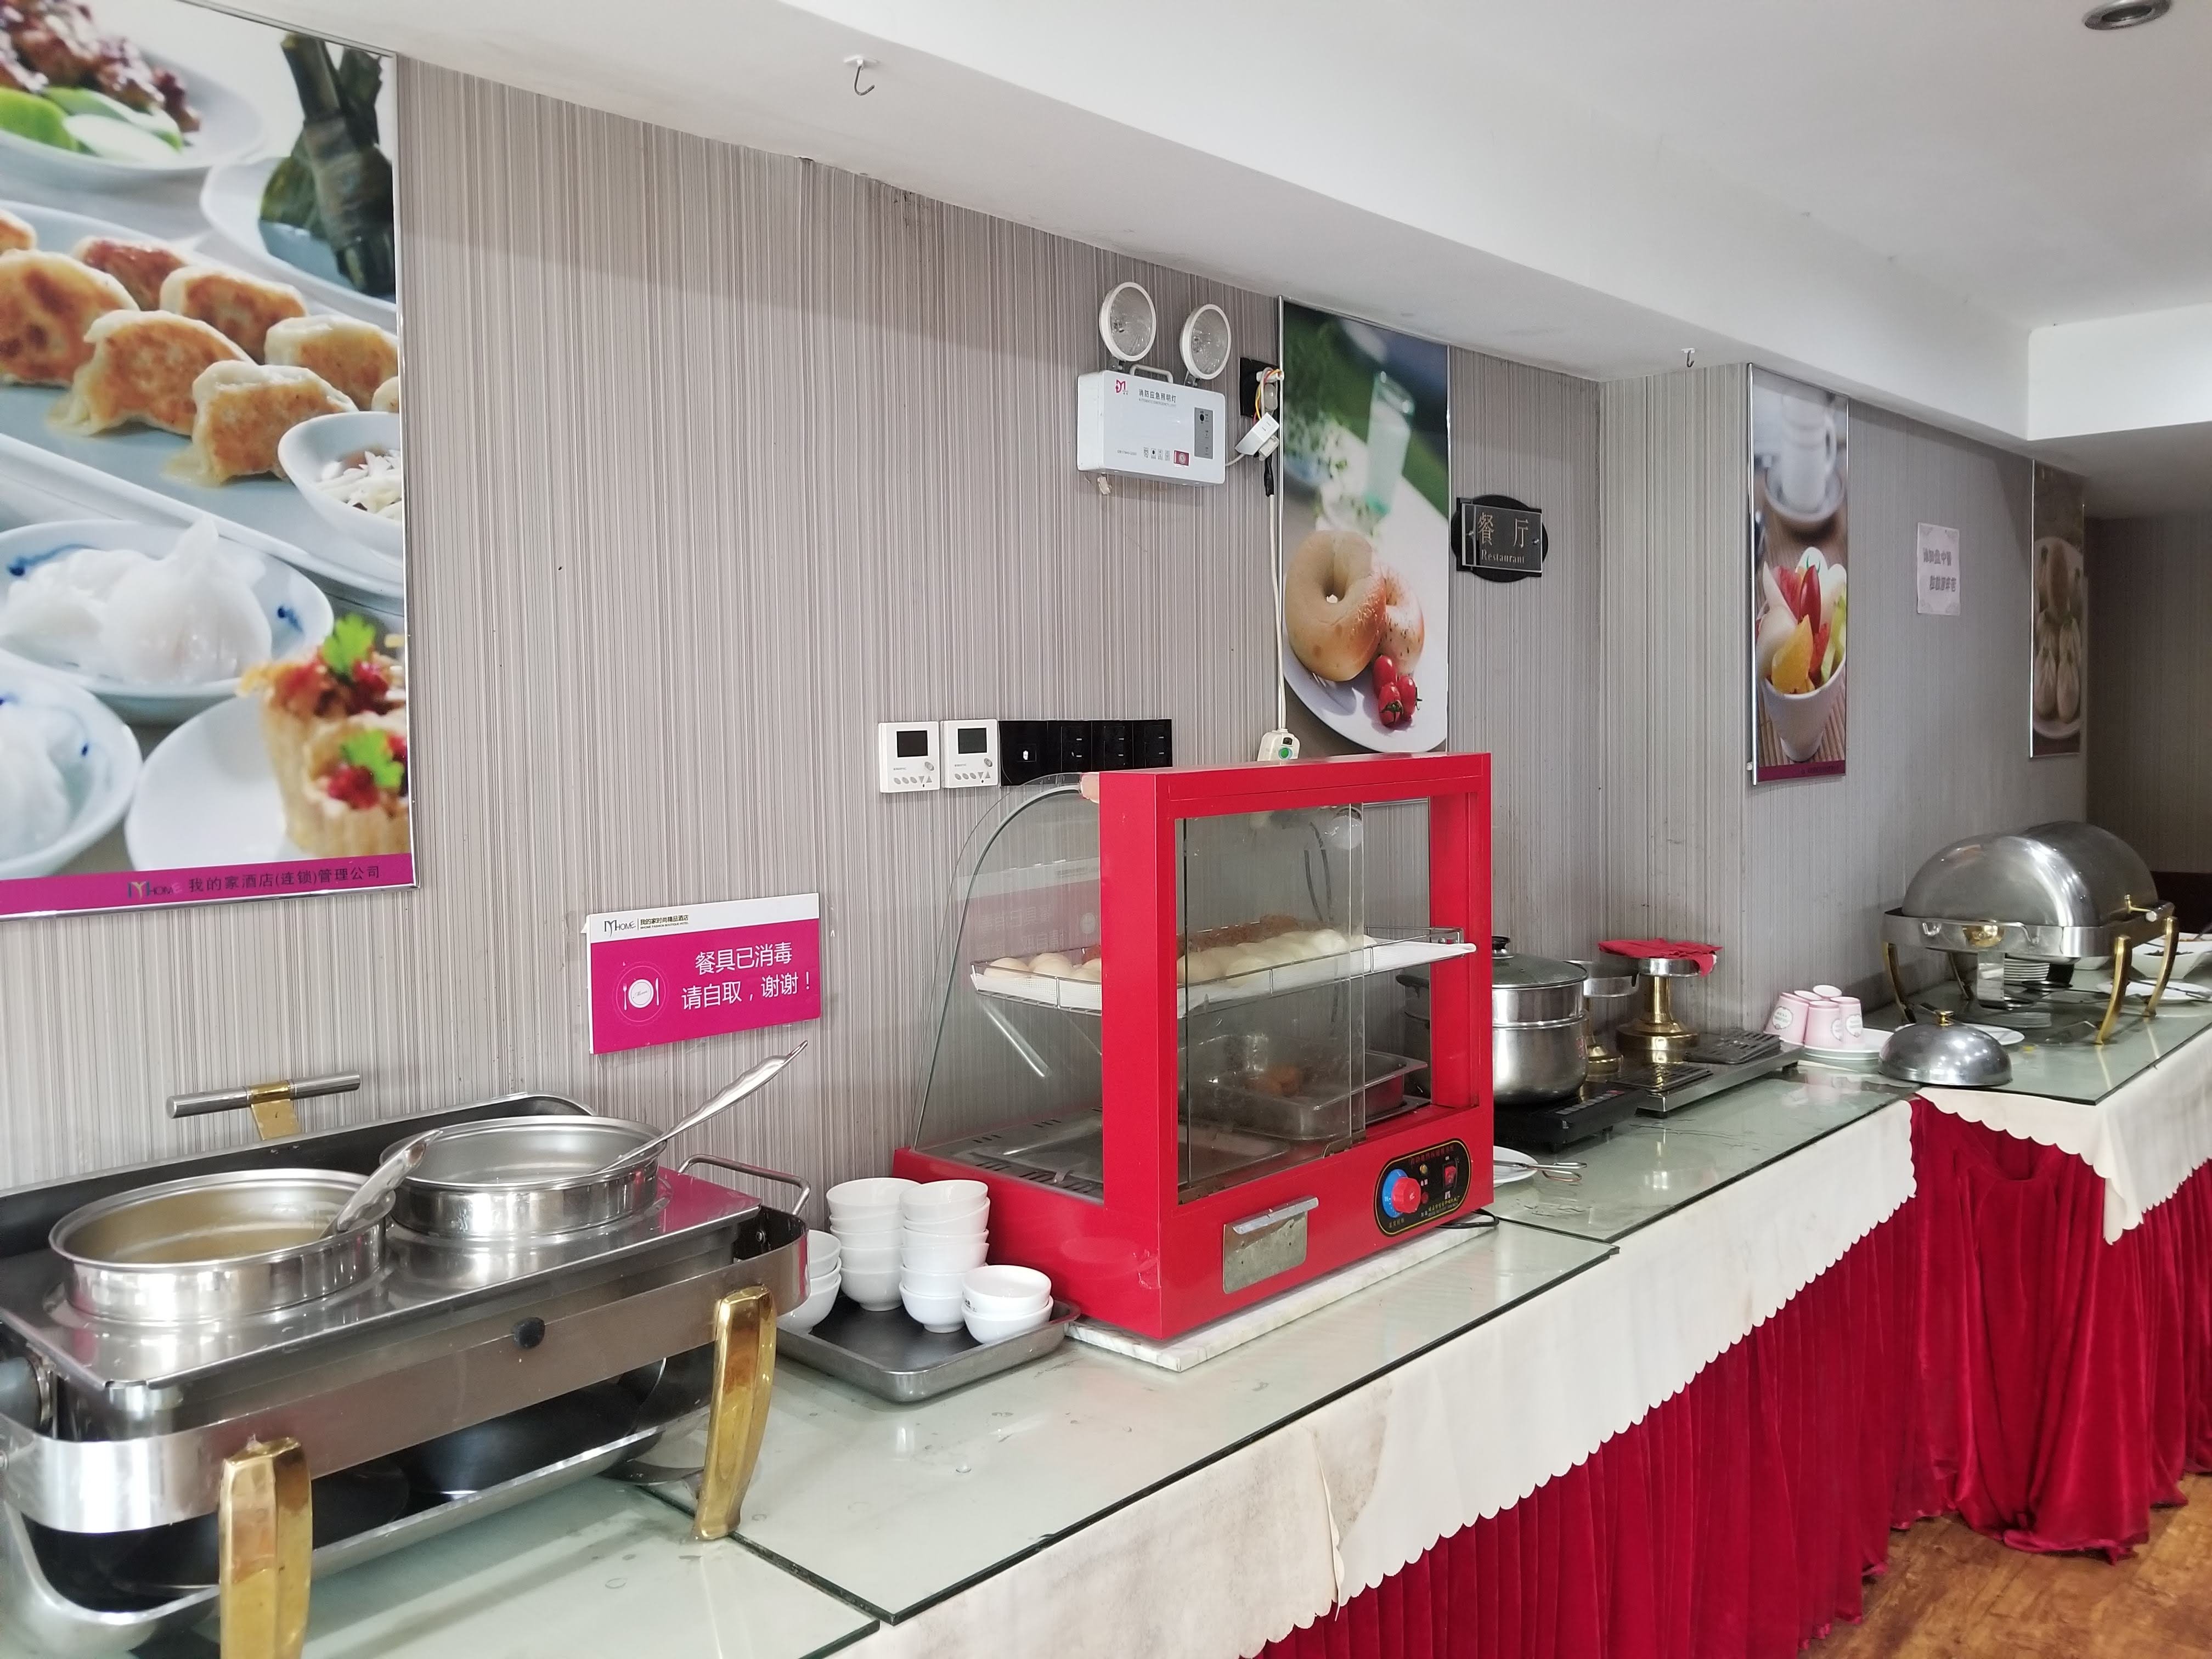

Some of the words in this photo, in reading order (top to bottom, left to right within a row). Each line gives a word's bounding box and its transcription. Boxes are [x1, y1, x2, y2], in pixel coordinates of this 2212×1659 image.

[1138, 388, 1177, 403] 消防应急照明灯
[1478, 511, 1529, 548] 餐厅
[1481, 549, 1525, 564] Restaurant
[188, 865, 380, 893] 我的家酒店(连锁)管理公司
[640, 915, 689, 926] 我的家时尚精品酒店
[695, 941, 793, 975] 餐具已消毒
